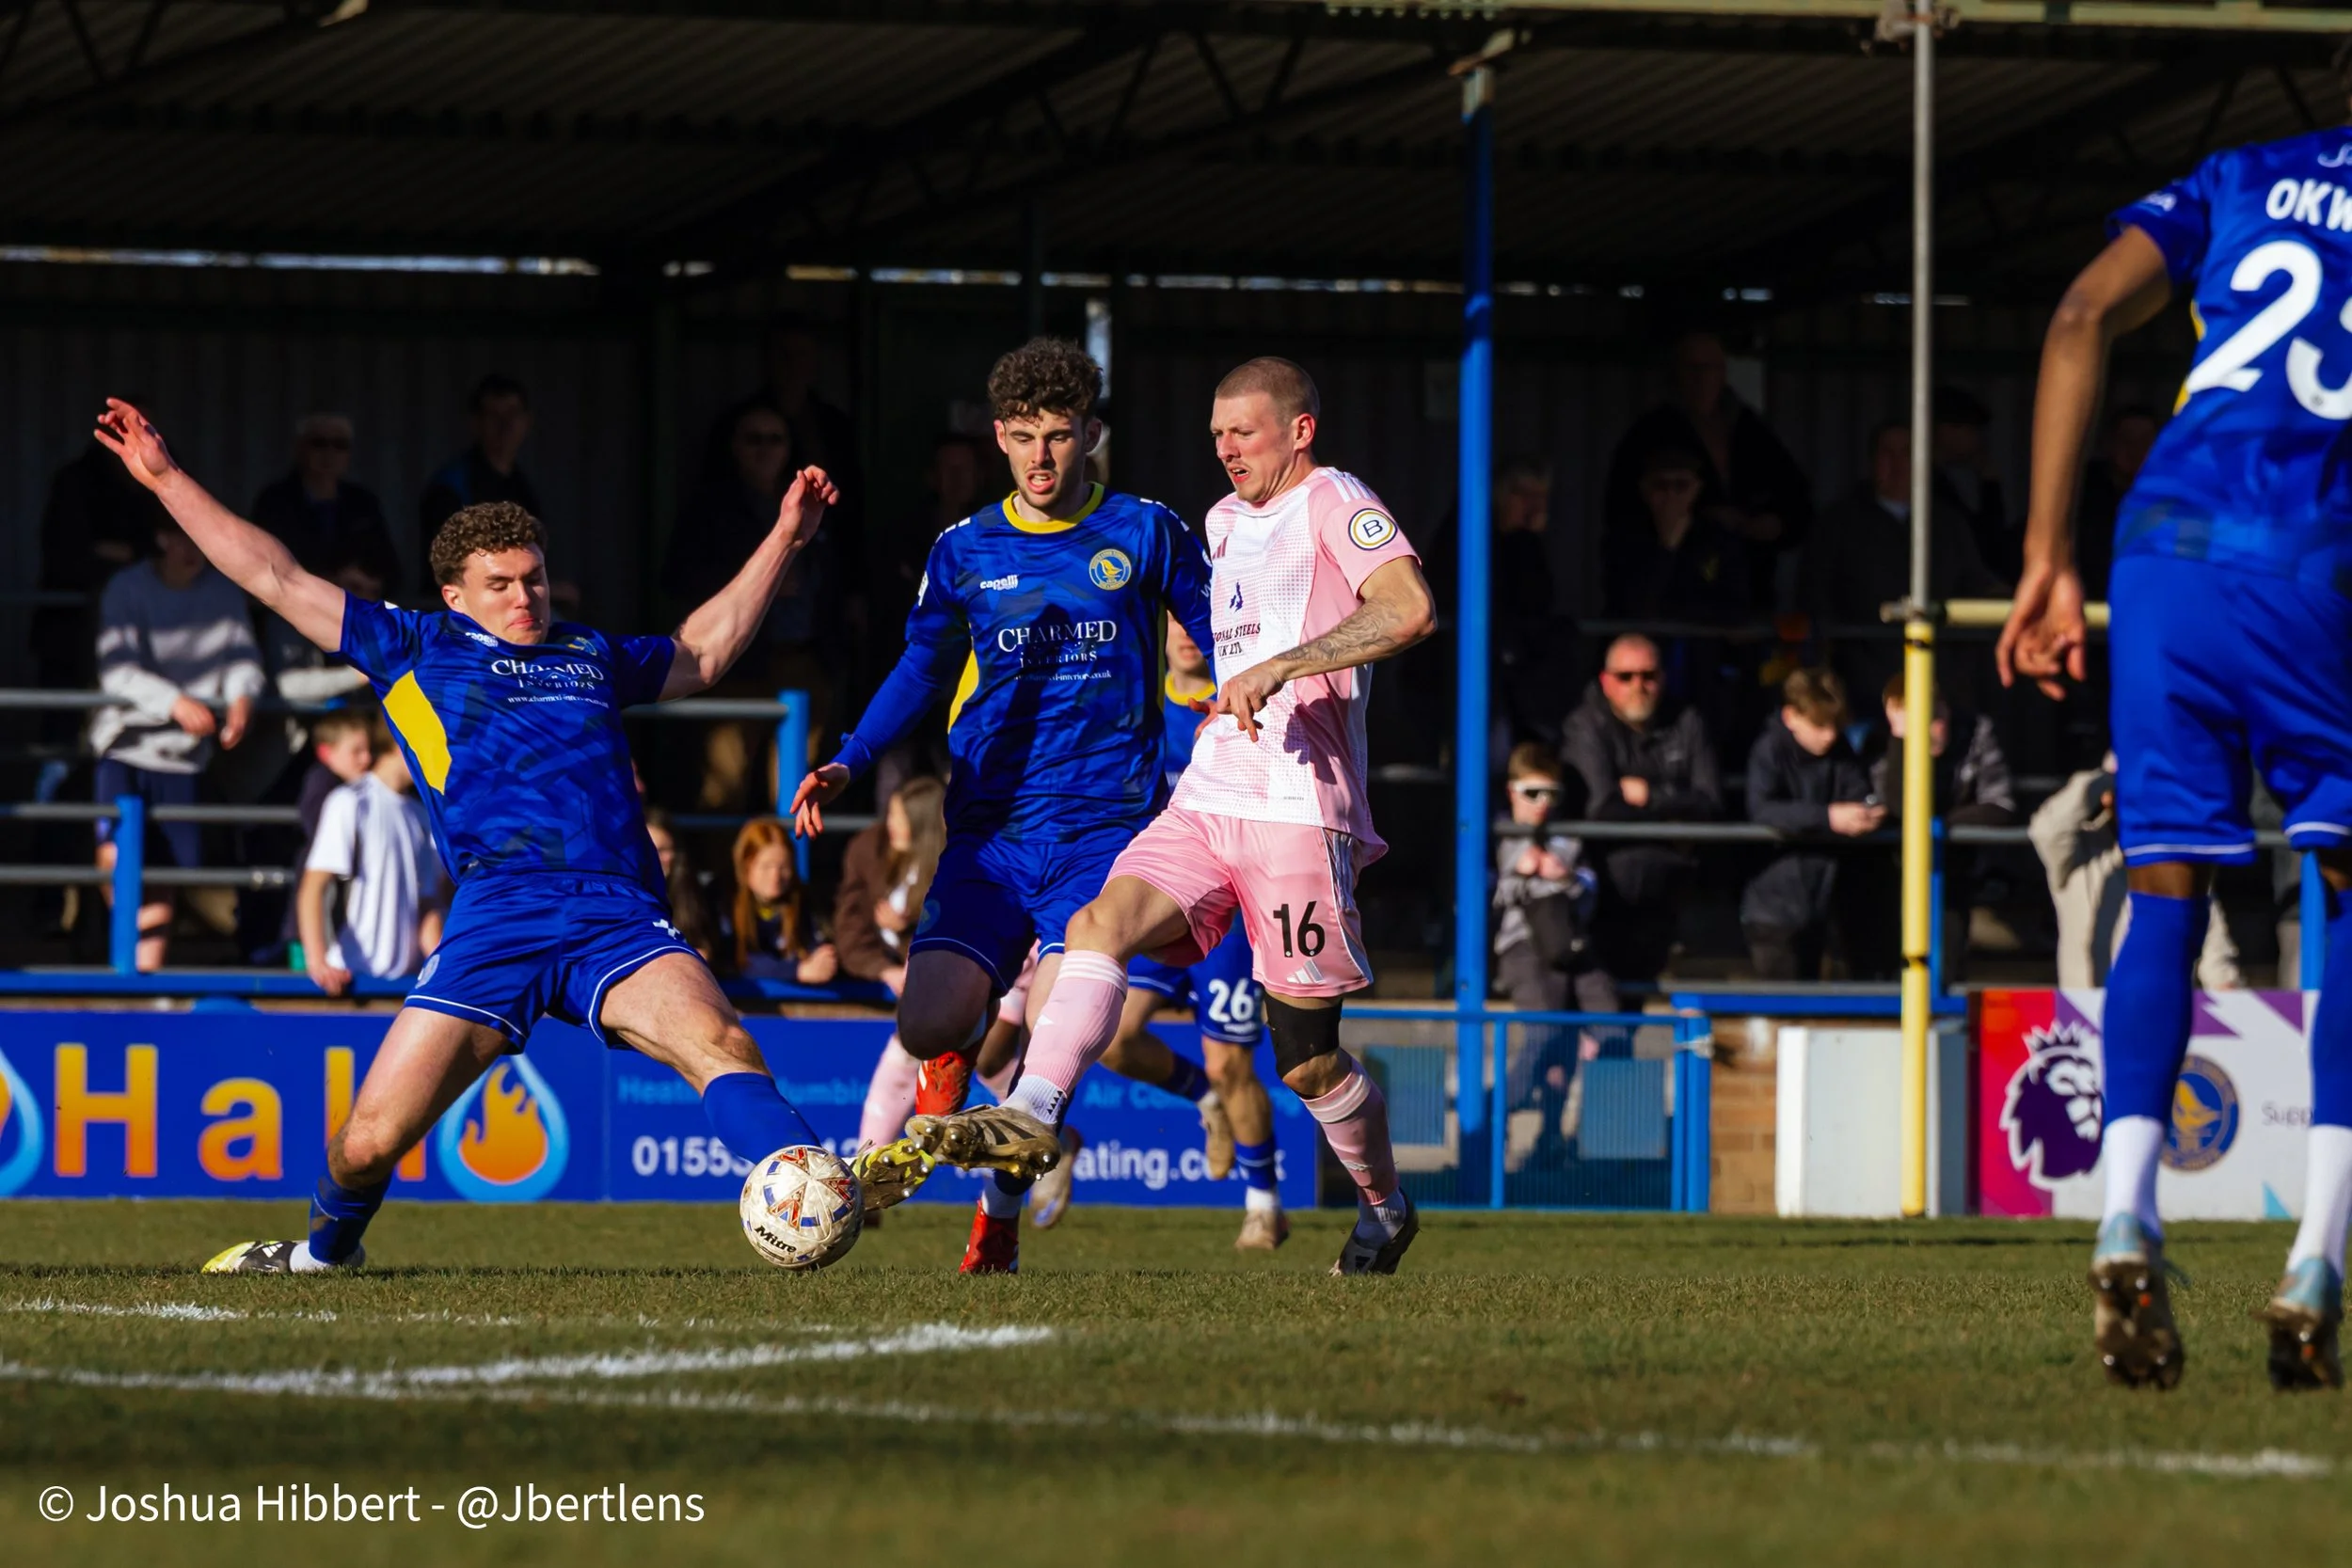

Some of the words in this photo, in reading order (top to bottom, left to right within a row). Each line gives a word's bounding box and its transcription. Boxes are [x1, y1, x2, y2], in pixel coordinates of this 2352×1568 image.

[997, 620, 1117, 652] CHARMED
[1273, 900, 1326, 958] 16
[1208, 978, 1254, 1022] 26
[55, 1043, 426, 1182] Hal
[755, 1225, 798, 1254] Mitre
